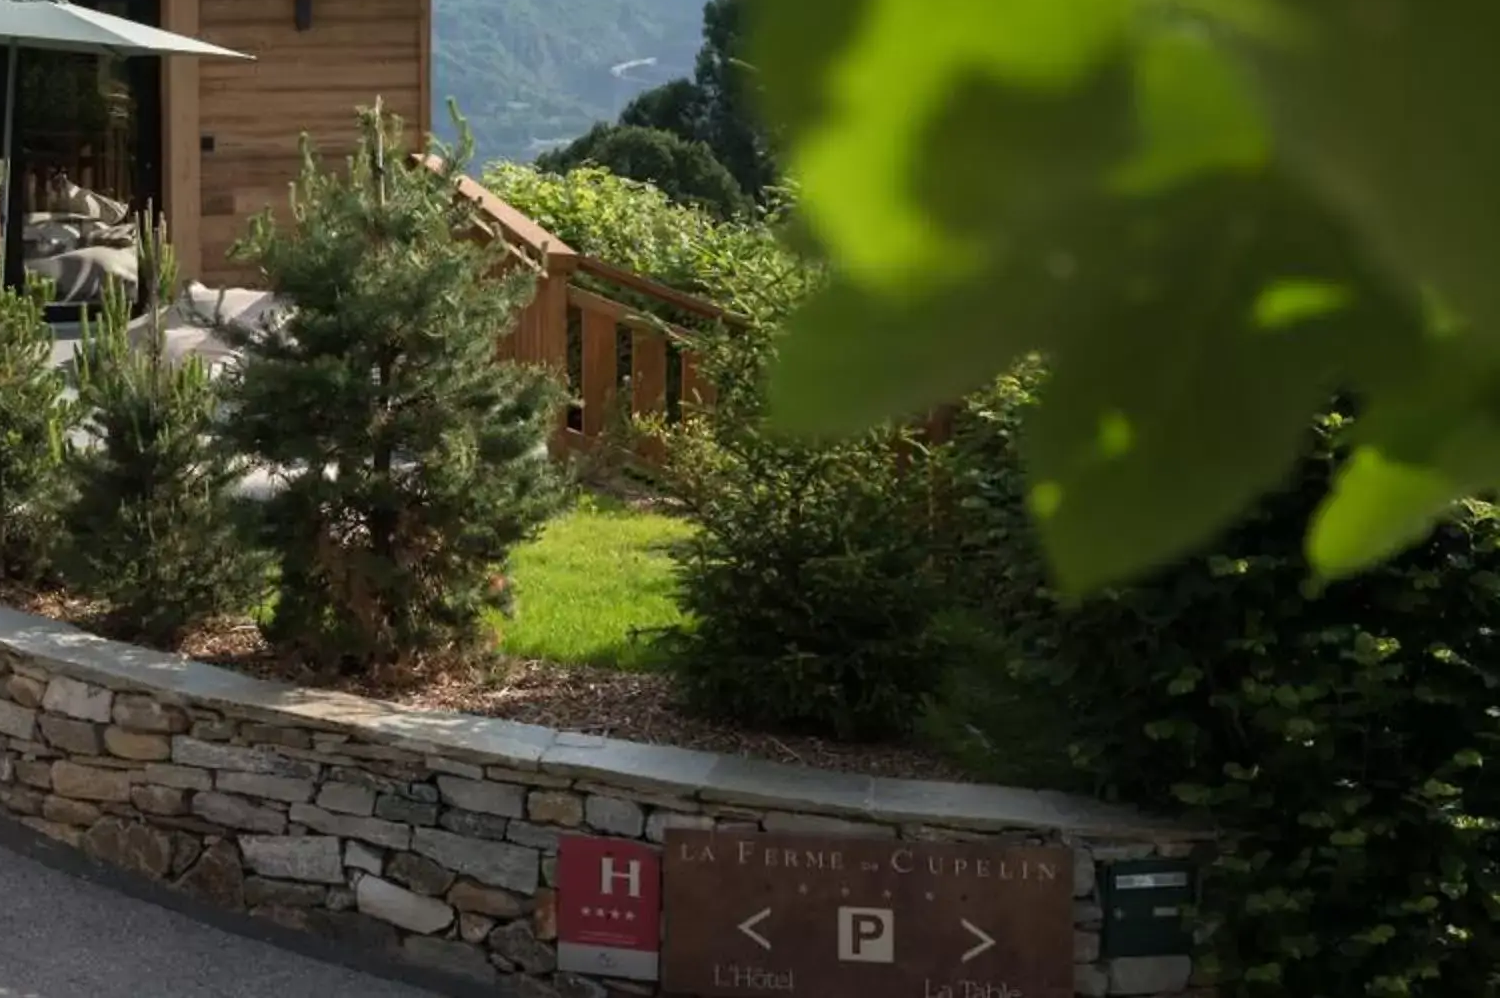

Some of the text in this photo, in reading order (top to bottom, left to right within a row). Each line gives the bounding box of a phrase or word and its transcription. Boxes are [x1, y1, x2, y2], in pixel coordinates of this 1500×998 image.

[601, 857, 641, 898] H
[680, 843, 716, 862] LA
[739, 841, 844, 870] FERME
[891, 849, 1057, 880] CUPELIN
[851, 913, 884, 954] P
[925, 978, 1023, 998] La Table
